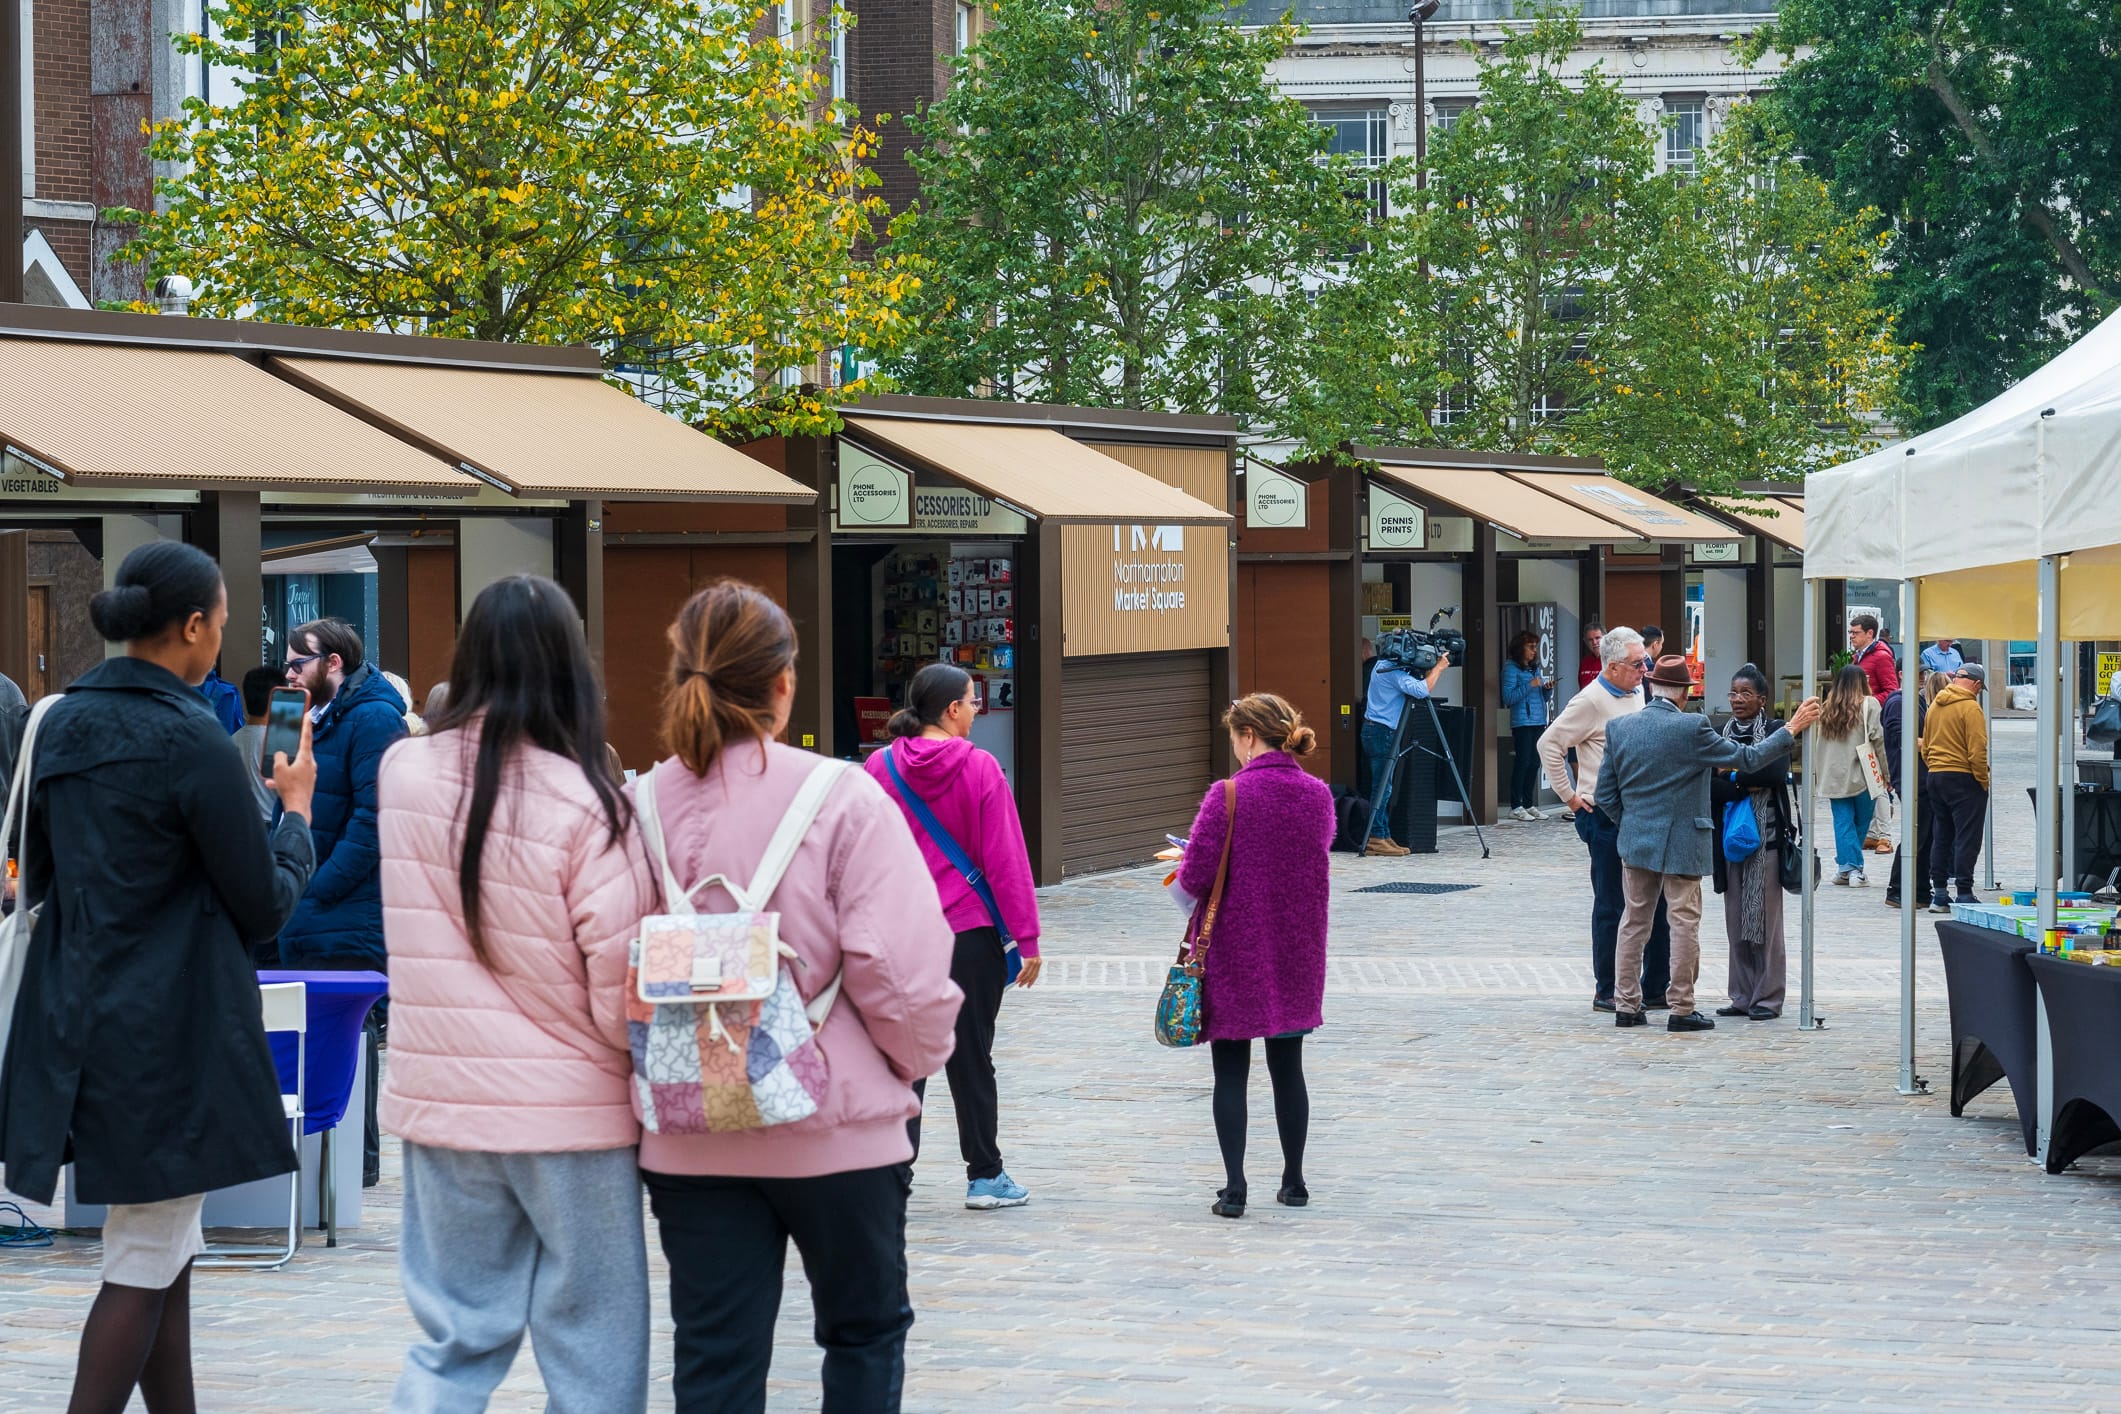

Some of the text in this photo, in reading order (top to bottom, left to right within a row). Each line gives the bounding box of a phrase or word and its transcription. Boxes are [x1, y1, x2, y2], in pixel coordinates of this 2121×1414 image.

[2, 479, 59, 493] VEGETABLES
[916, 495, 991, 517] CESSORIES LTD
[1381, 517, 1414, 525] DENNIS
[1381, 526, 1413, 534] PRINTS
[1114, 557, 1185, 590] Northampton
[1114, 586, 1185, 615] Market Square
[2103, 663, 2120, 671] BU
